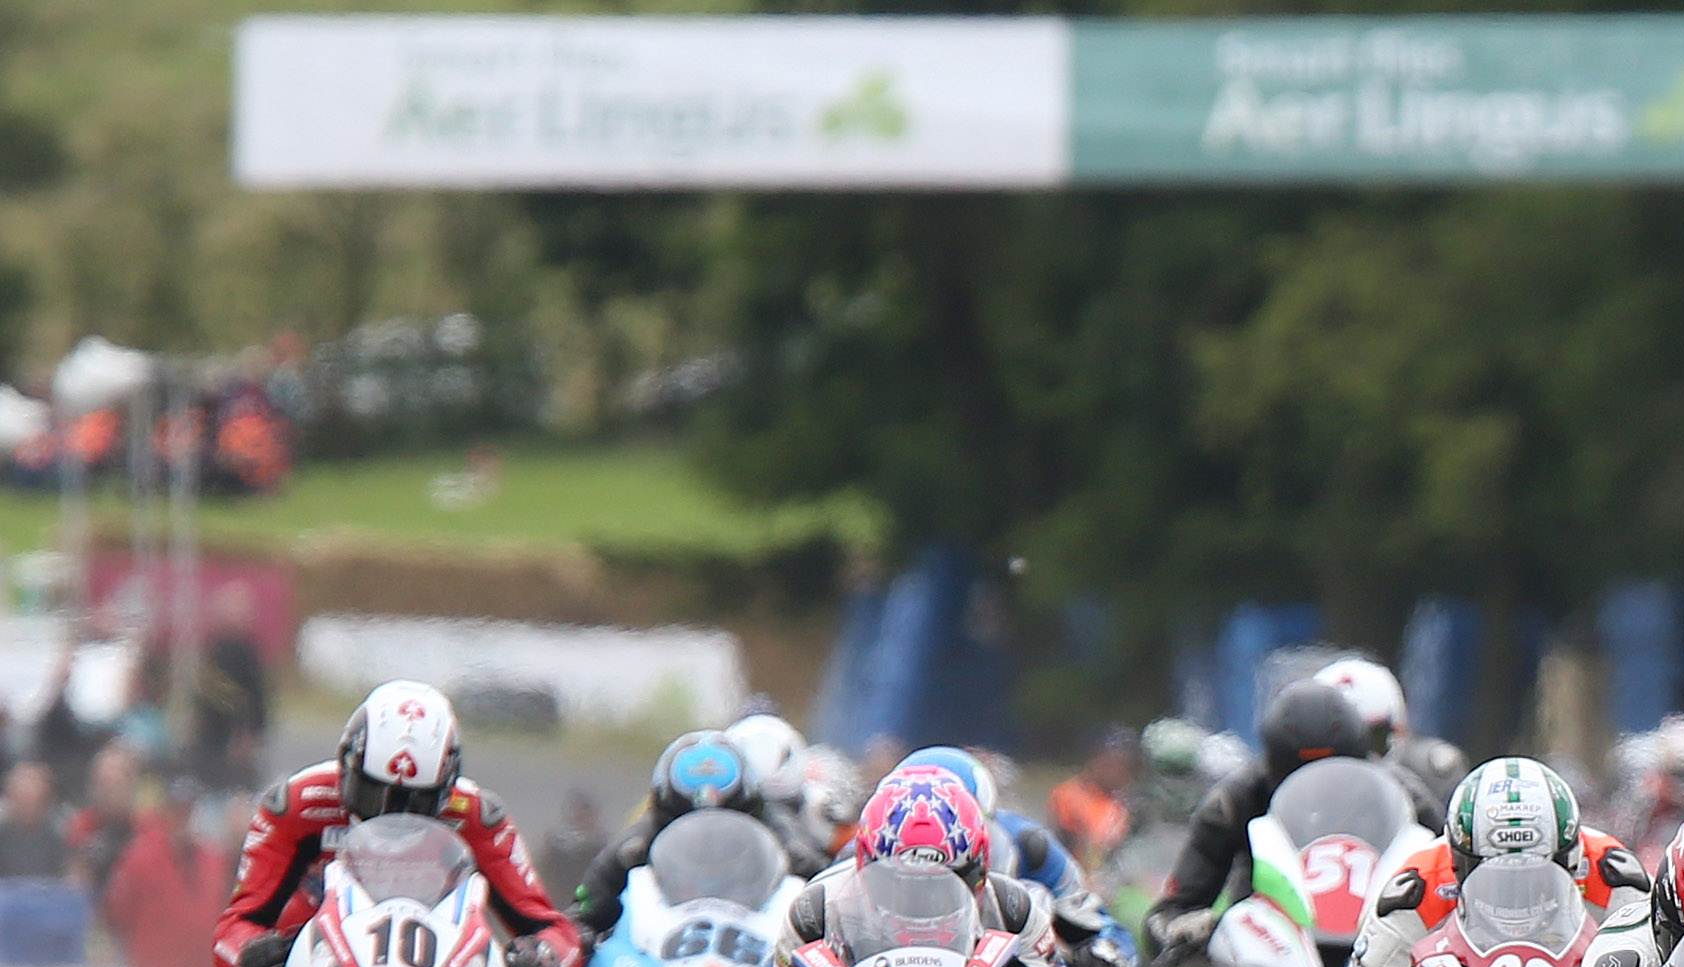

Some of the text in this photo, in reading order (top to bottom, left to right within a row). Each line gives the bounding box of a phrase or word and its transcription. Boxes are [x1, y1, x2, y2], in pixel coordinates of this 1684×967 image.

[384, 77, 799, 158] Aer Lingus
[1203, 77, 1628, 173] Aer Lingus
[1496, 830, 1534, 843] SHOEI
[1303, 843, 1374, 897] 51
[895, 956, 943, 967] BURDENS
